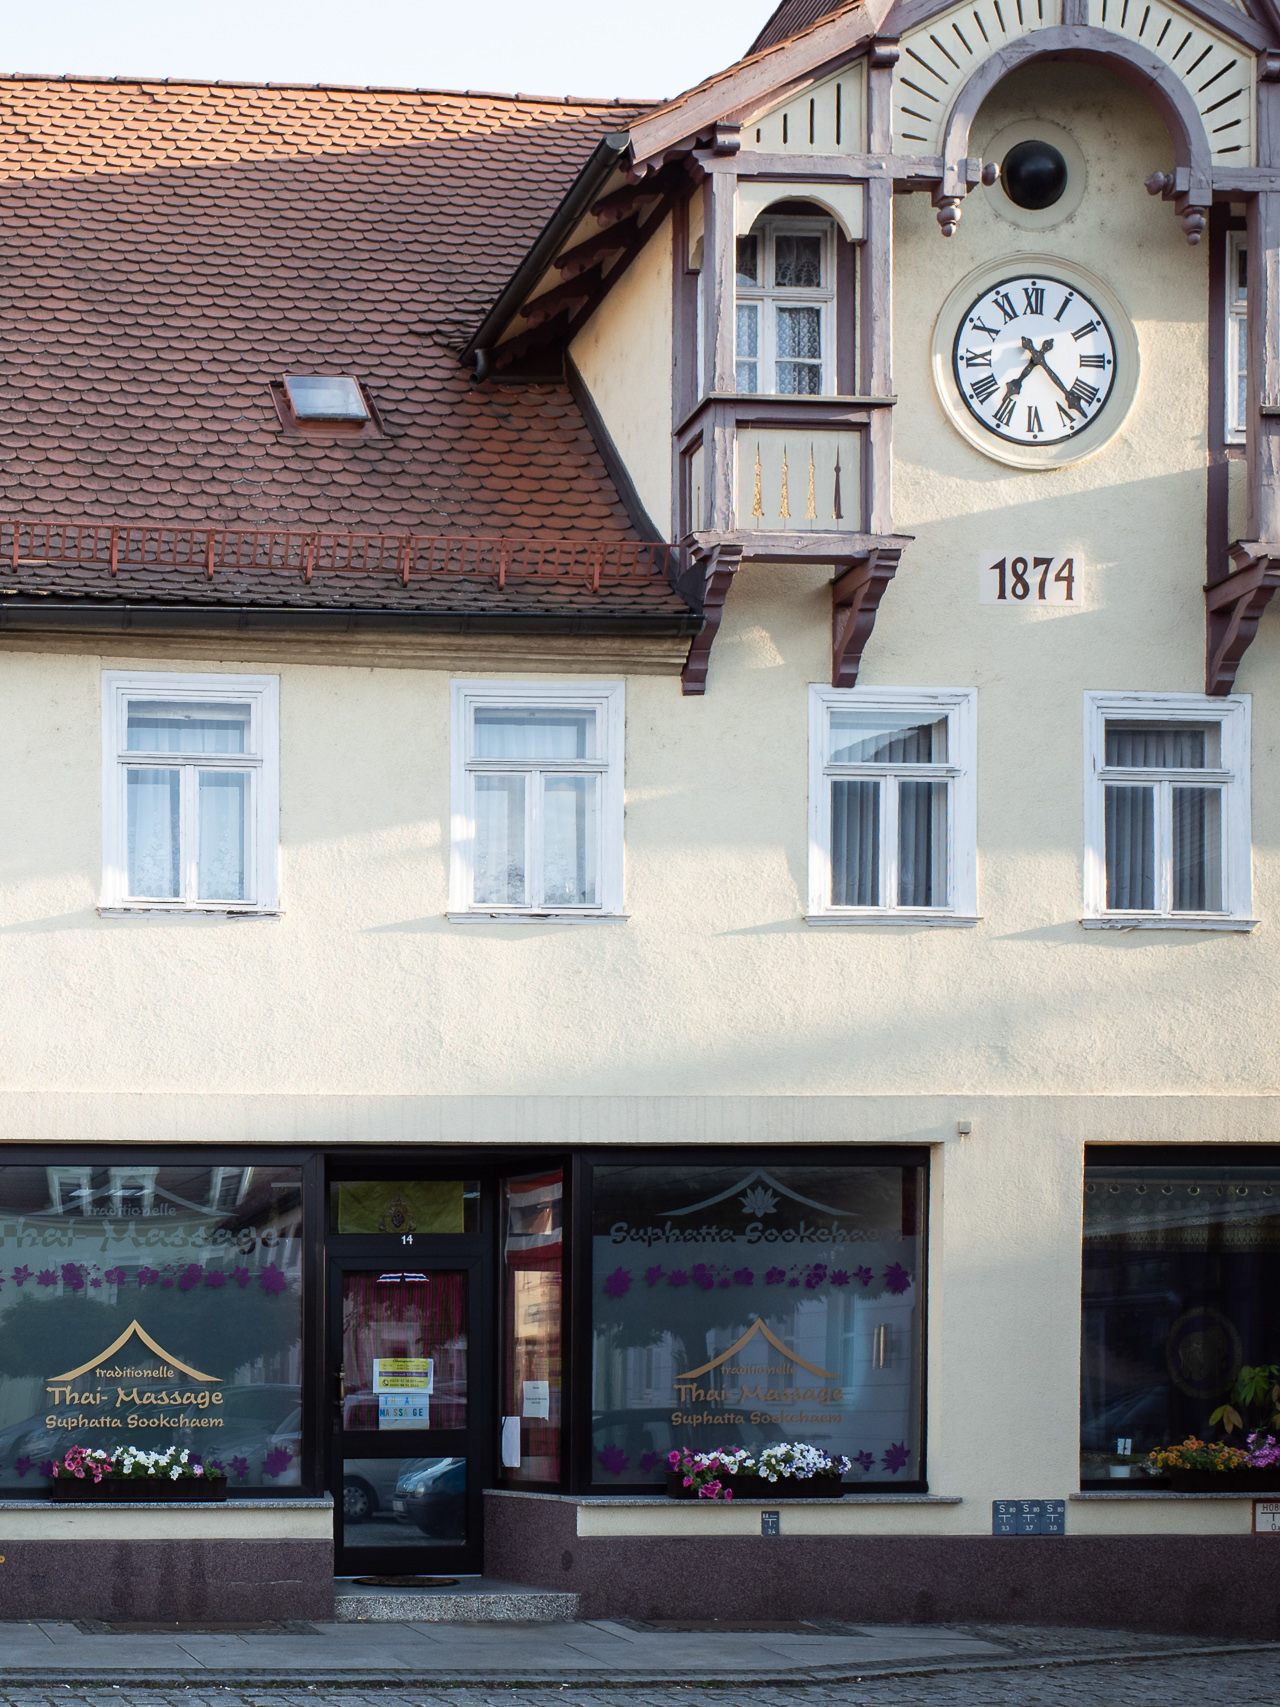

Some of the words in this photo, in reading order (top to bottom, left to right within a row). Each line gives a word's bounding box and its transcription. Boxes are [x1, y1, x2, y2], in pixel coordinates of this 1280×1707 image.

[992, 292, 1019, 325] XI
[1022, 288, 1045, 315] XII
[1053, 295, 1073, 322] I
[971, 316, 1001, 342] X
[1071, 319, 1098, 342] II
[1079, 353, 1106, 370] III
[1026, 406, 1044, 432] VI
[989, 556, 1075, 600] 1874
[99, 1218, 280, 1255] Massage
[401, 1235, 413, 1245] 14
[610, 1221, 736, 1247] Suphatta
[96, 1366, 174, 1379] traditionelle
[721, 1363, 797, 1376] traditionelle
[46, 1385, 108, 1406] Thai-
[116, 1387, 224, 1409] Massage
[673, 1382, 732, 1403] Thai-
[740, 1384, 843, 1405] Massage
[45, 1414, 122, 1430] Suphatta
[127, 1413, 224, 1429] Sookchaem
[671, 1411, 744, 1427] Suphatta
[750, 1411, 843, 1426] Sookchaem
